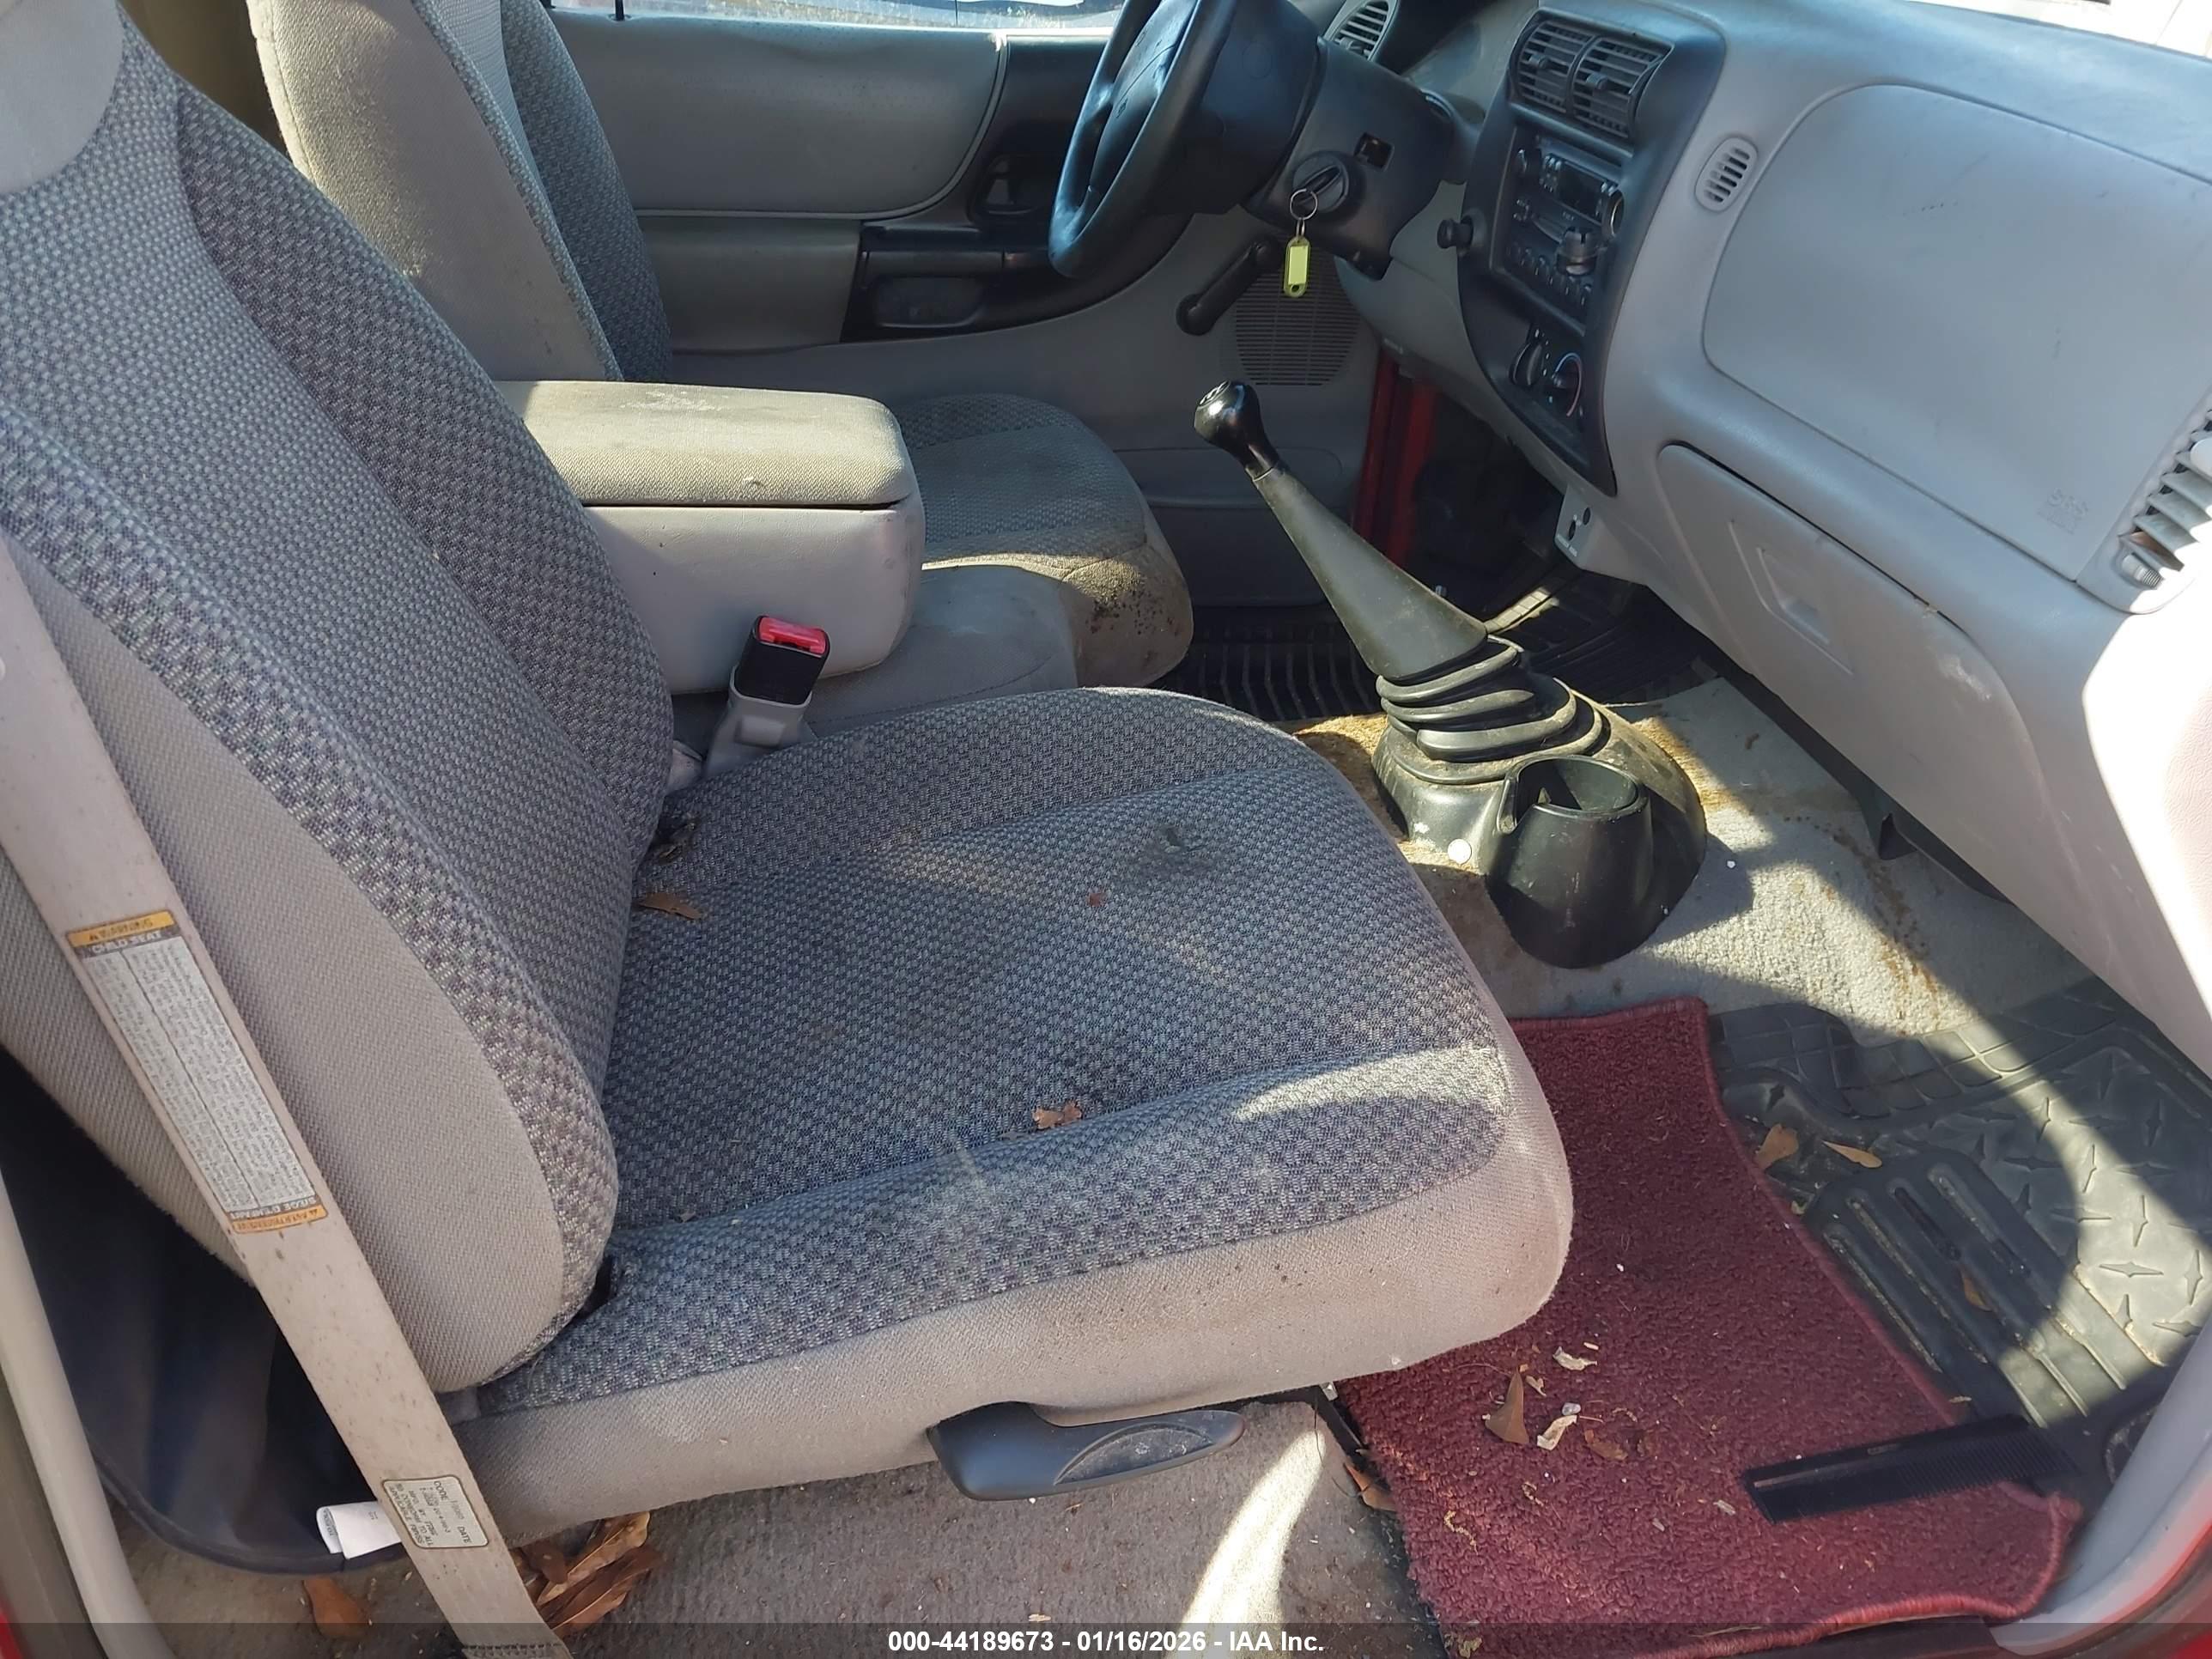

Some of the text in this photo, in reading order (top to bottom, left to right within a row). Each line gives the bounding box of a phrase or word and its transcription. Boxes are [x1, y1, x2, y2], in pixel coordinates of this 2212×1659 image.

[92, 930, 161, 953] CHILD SEAT
[433, 1480, 449, 1500] CODE
[457, 1526, 472, 1543] DATE
